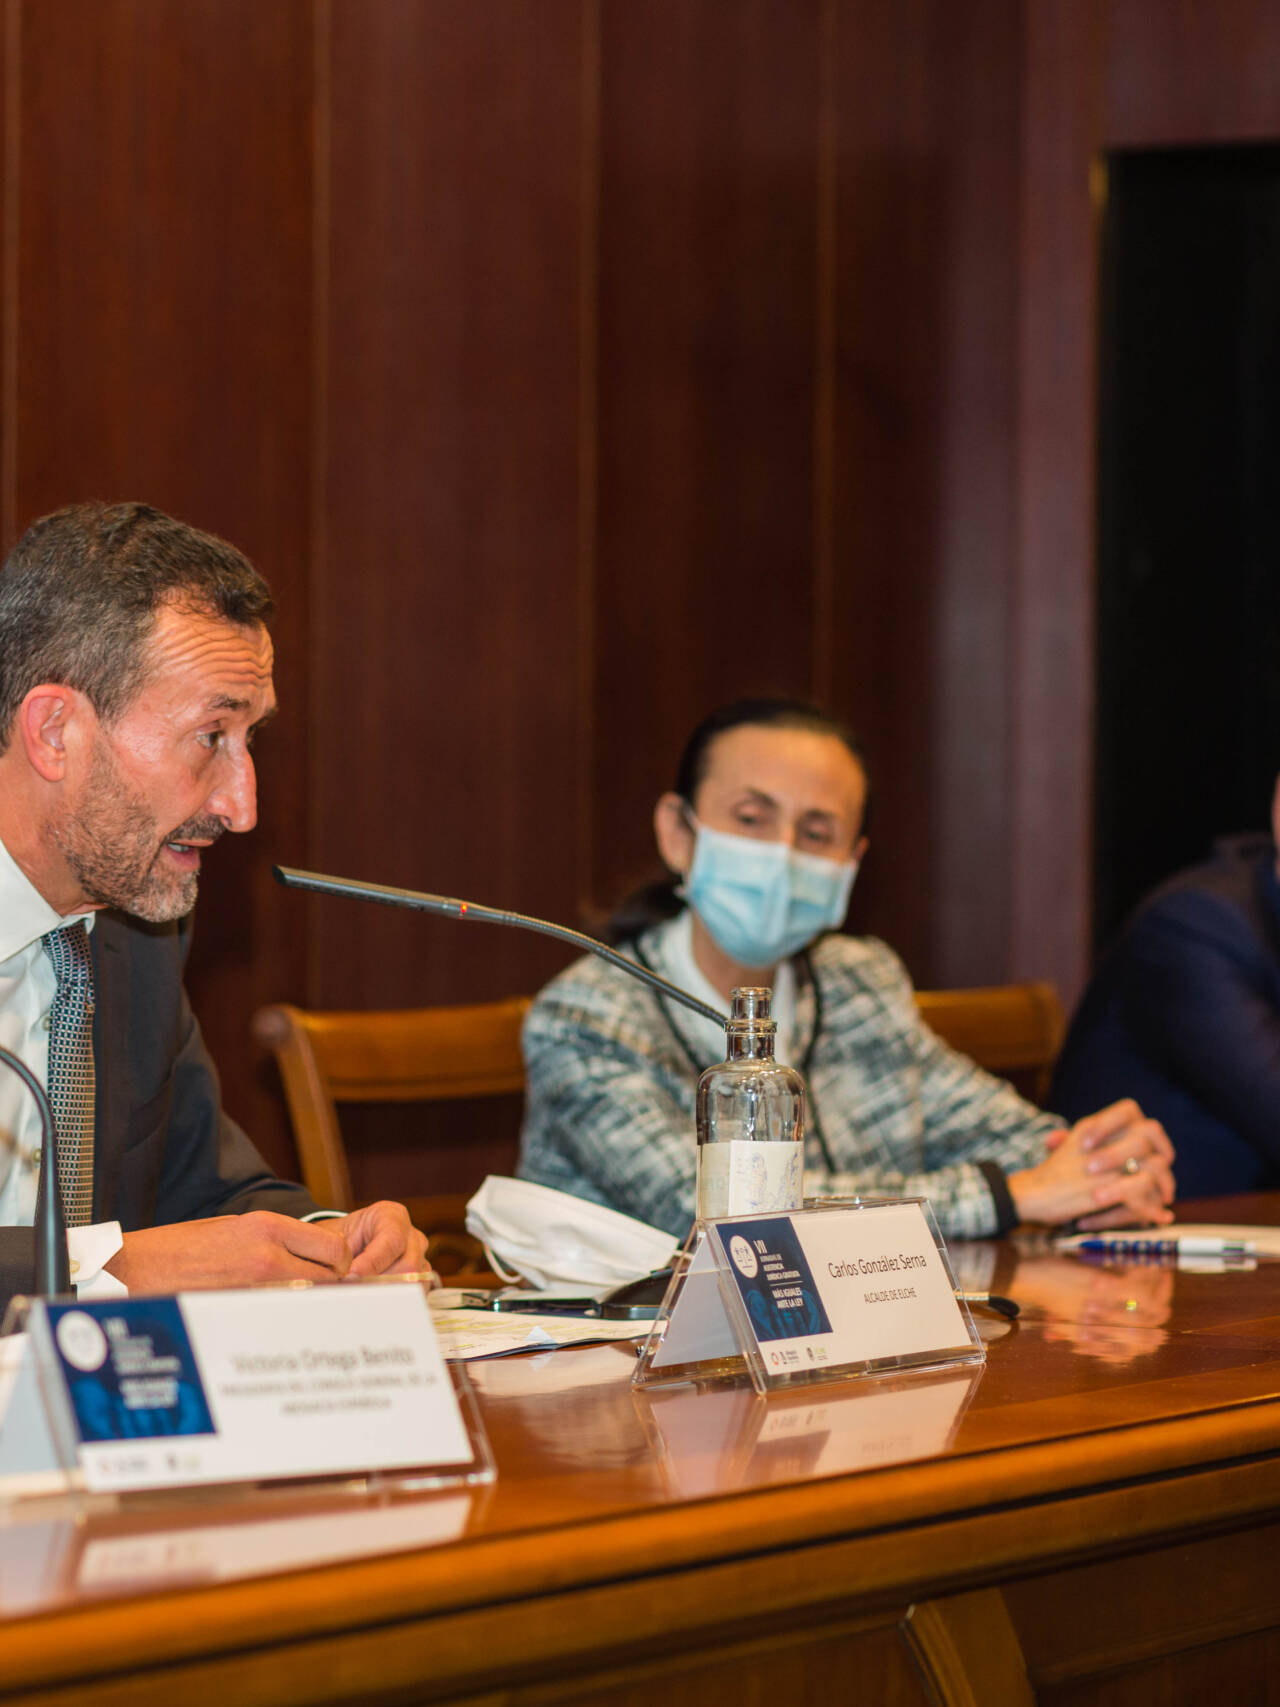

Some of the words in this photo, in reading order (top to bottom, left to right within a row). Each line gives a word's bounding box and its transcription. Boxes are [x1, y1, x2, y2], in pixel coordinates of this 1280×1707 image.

[828, 1258, 859, 1279] Carlos
[858, 1254, 901, 1275] González
[898, 1253, 927, 1270] Serna
[864, 1290, 890, 1304] ALCALDE
[898, 1287, 917, 1300] ELCHE
